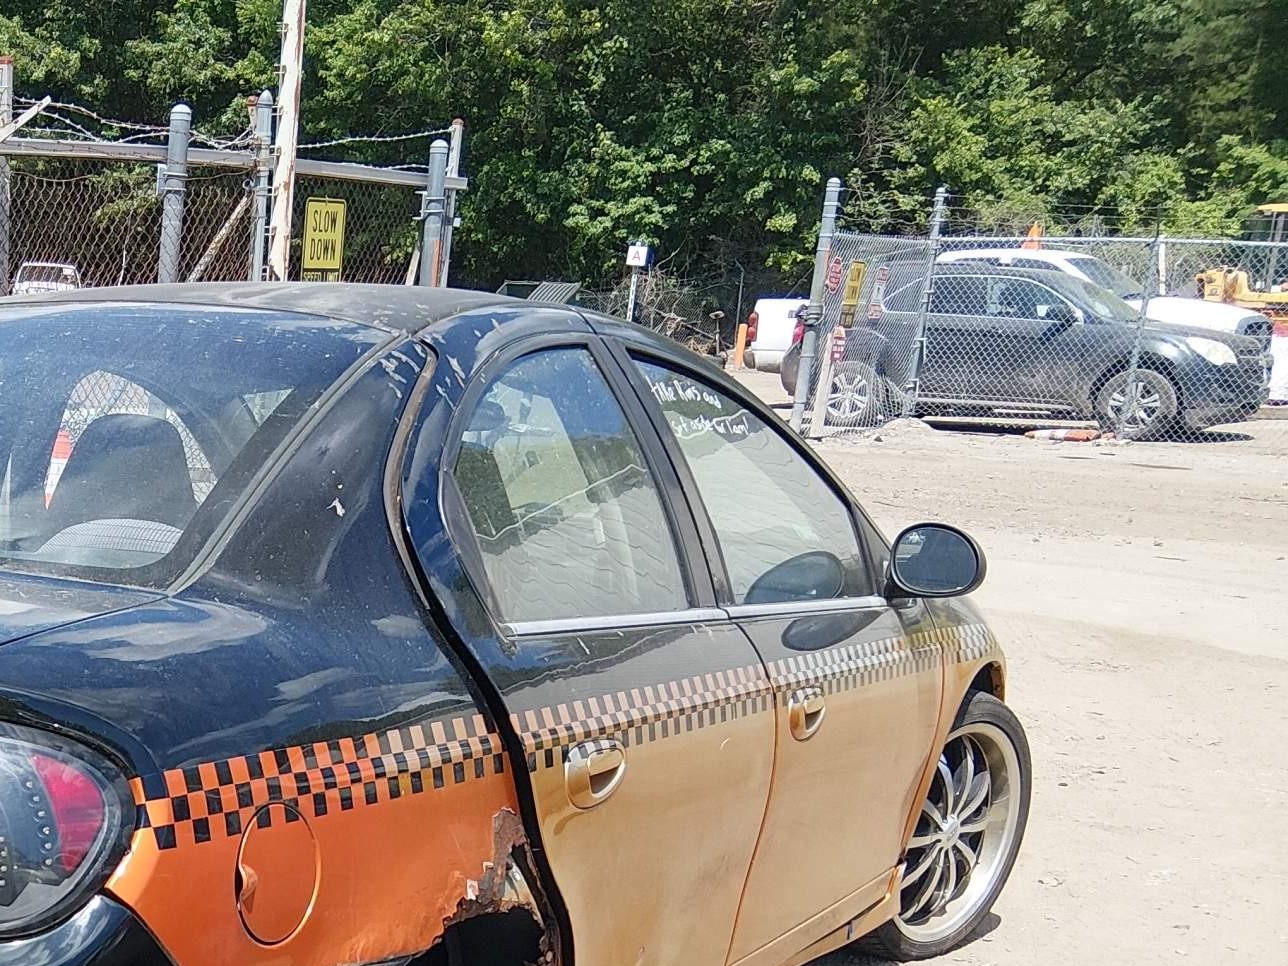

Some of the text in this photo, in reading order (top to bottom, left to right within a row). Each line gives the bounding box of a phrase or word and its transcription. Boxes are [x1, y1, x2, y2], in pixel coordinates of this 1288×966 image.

[312, 209, 338, 234] SLOW
[309, 238, 337, 261] DOWN
[631, 249, 641, 262] A
